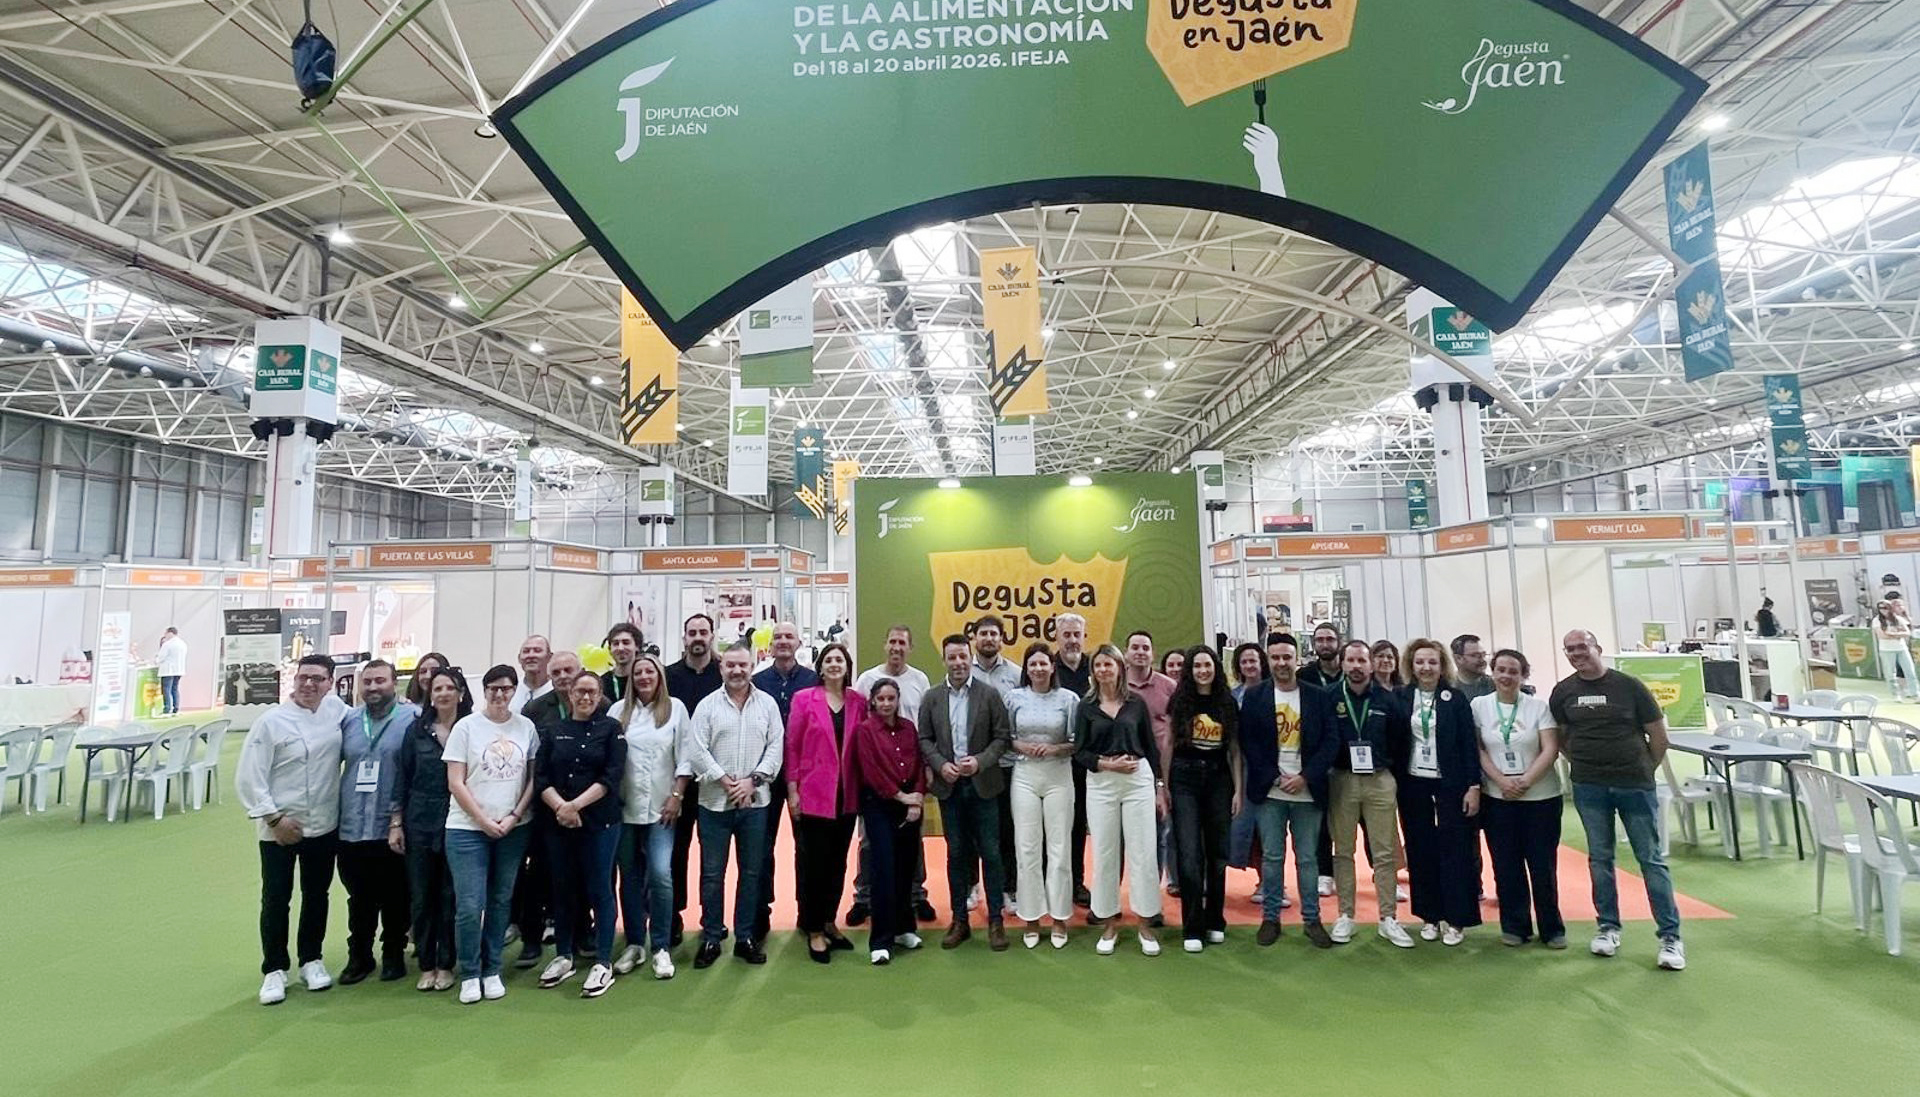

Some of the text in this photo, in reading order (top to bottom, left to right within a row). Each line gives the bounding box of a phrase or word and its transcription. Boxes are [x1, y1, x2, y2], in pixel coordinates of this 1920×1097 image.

[793, 5, 835, 28] DE
[842, 3, 882, 25] LA
[793, 14, 1109, 55] Y LA GASTRONOMÍA
[1183, 16, 1324, 51] en Jaén
[793, 49, 1070, 77] Del 18 al 20 abril 2026. IFEJA
[645, 104, 739, 121] DIPUTACIÓN
[645, 121, 707, 137] DE JAÉN
[1586, 522, 1647, 534] VERMUT LOA
[1310, 542, 1350, 550] APISIERRA
[380, 550, 474, 561] PUERTA DE LAS VILLAS
[662, 555, 719, 566] SANTA CLAUDIA
[1002, 612, 1087, 646] Jaé
